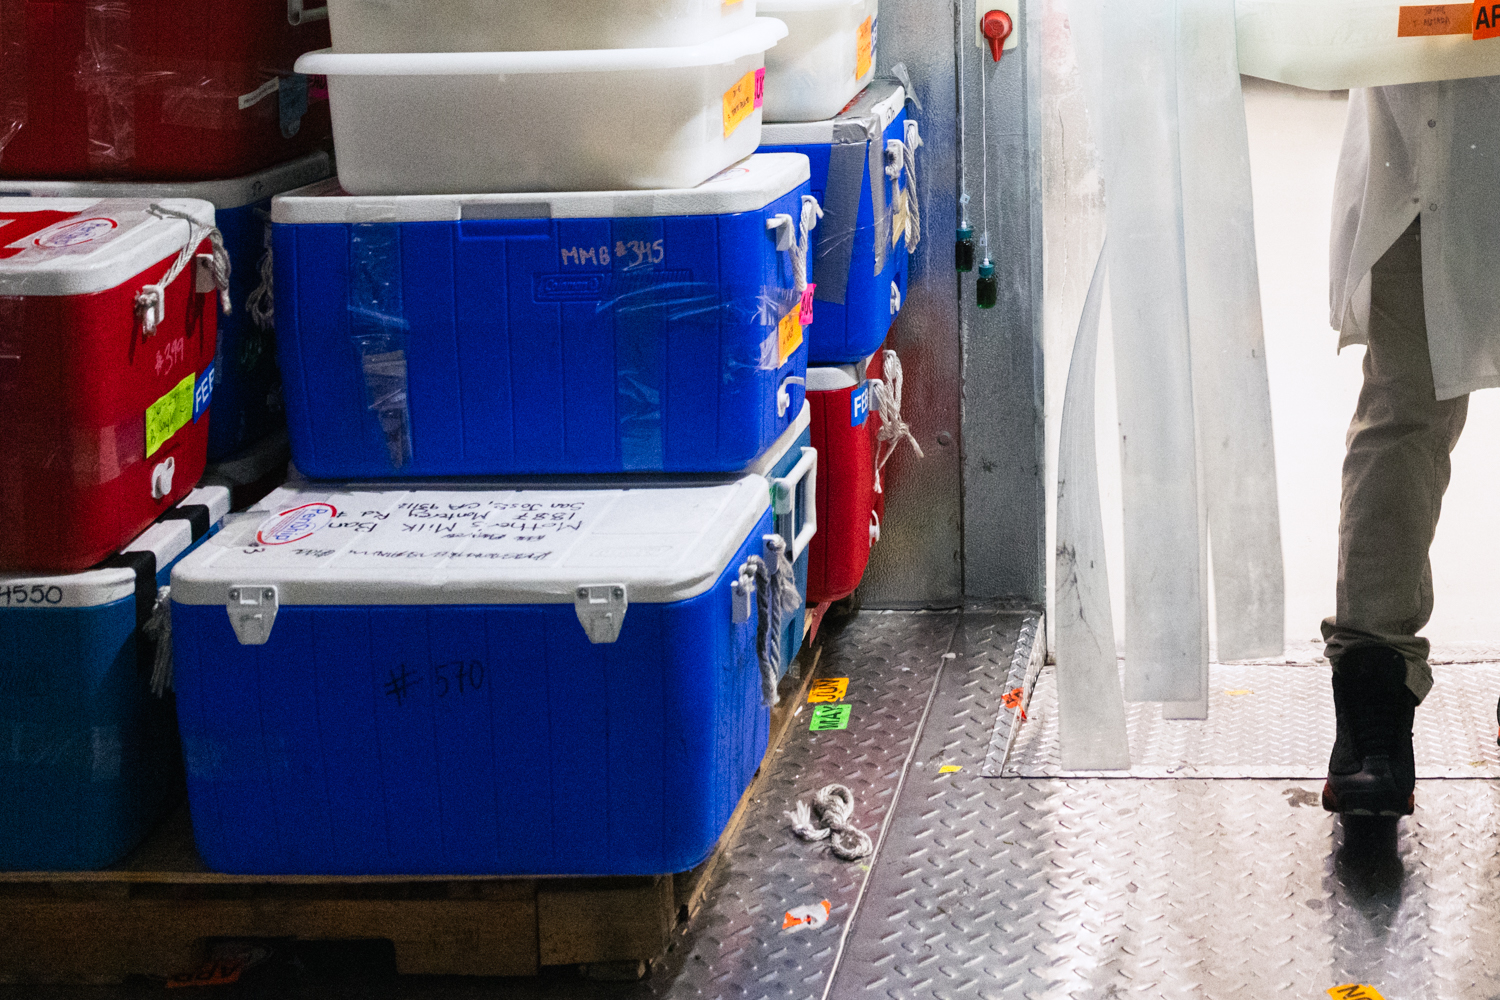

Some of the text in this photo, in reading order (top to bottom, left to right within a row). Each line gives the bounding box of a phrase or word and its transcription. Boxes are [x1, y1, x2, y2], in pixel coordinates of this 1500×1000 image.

[854, 387, 868, 418] FEB
[550, 502, 585, 511] San
[328, 522, 377, 532] Ban
